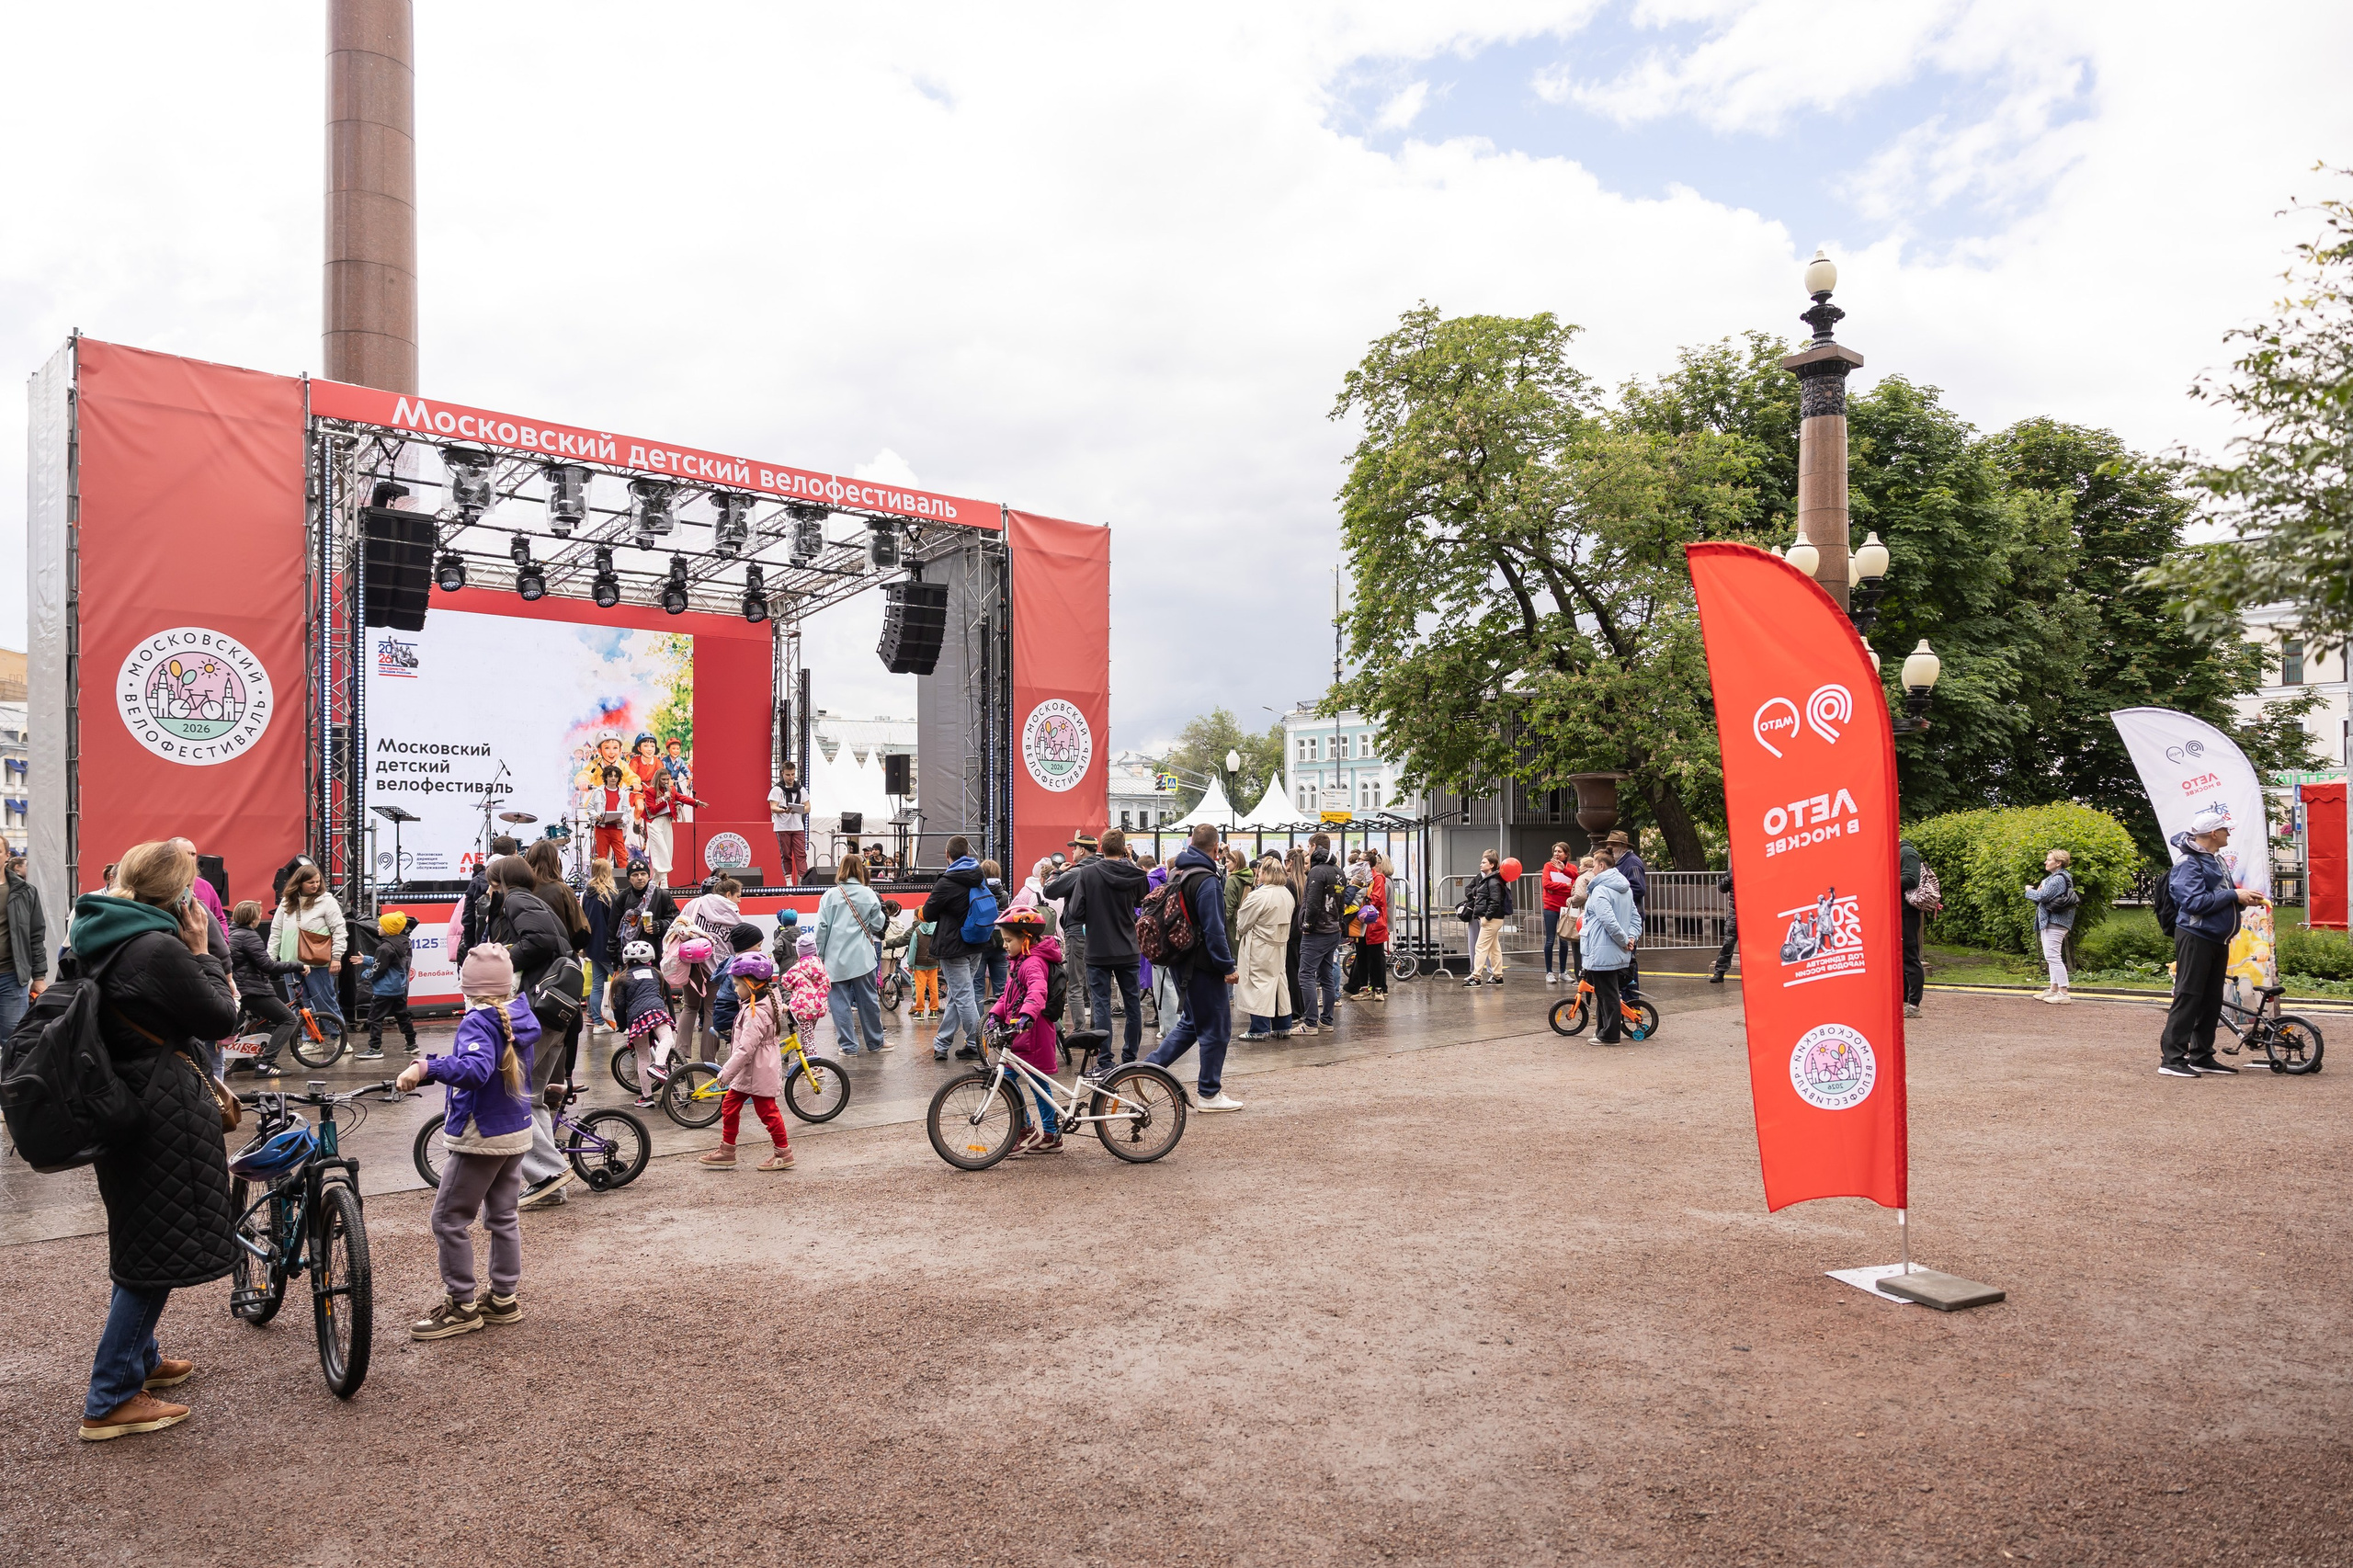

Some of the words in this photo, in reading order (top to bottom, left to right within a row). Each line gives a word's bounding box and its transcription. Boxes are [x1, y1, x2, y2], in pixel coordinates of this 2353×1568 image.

[392, 396, 617, 461] Московский
[628, 445, 751, 485] детский
[760, 469, 958, 519] велофестиваль
[128, 632, 265, 683] МОСКОВСКИЙ
[124, 694, 266, 759] ВЕЛОФЕСТИВАЛЬ
[183, 723, 210, 733] 2026
[1027, 702, 1088, 736] МОСКОВСКИЙ
[377, 738, 491, 756] Московский
[375, 759, 450, 774] детский
[1025, 744, 1089, 788] ВЕЛОФЕСТИВАЛЬ
[376, 777, 514, 795] велофестиваль
[2276, 773, 2347, 785] АПТЕК
[460, 852, 484, 864] ЛЕ
[417, 970, 454, 978] Велобайк
